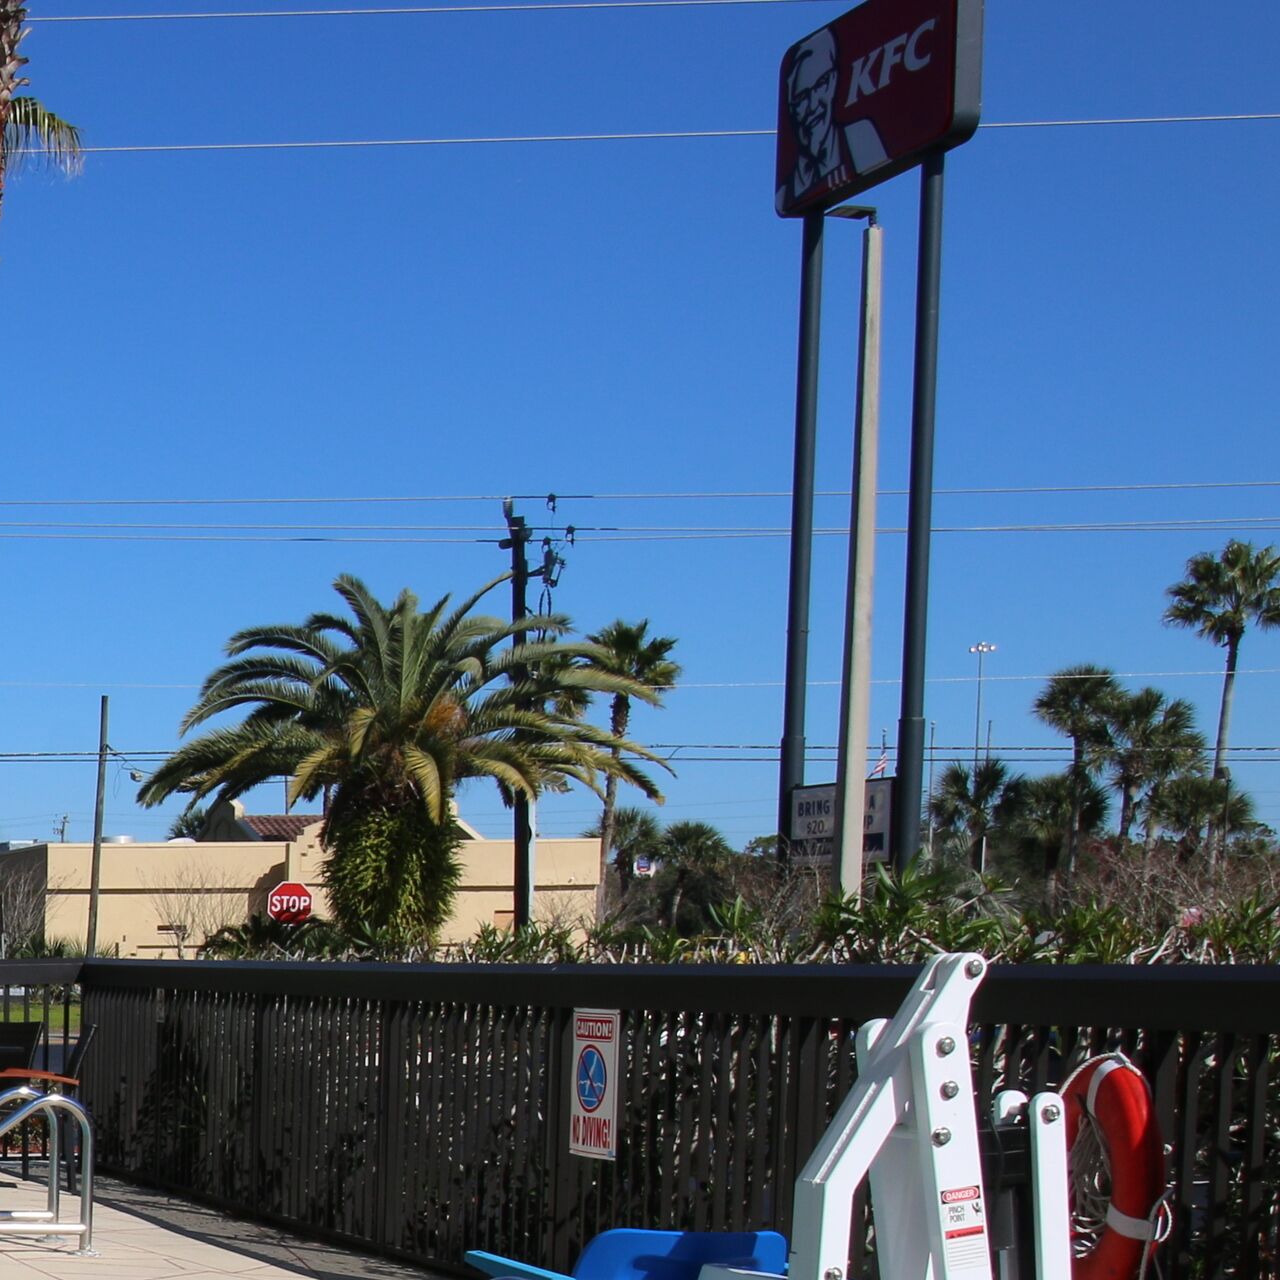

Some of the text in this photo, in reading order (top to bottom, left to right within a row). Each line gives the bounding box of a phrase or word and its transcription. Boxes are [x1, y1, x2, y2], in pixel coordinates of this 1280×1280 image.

[844, 18, 936, 108] KFC
[798, 800, 830, 817] BRING
[271, 896, 310, 912] STOP
[576, 1021, 612, 1038] CAUTION!
[572, 1114, 611, 1149] NO DIVING!
[946, 1189, 975, 1201] DANGER
[950, 1214, 965, 1223] POINT
